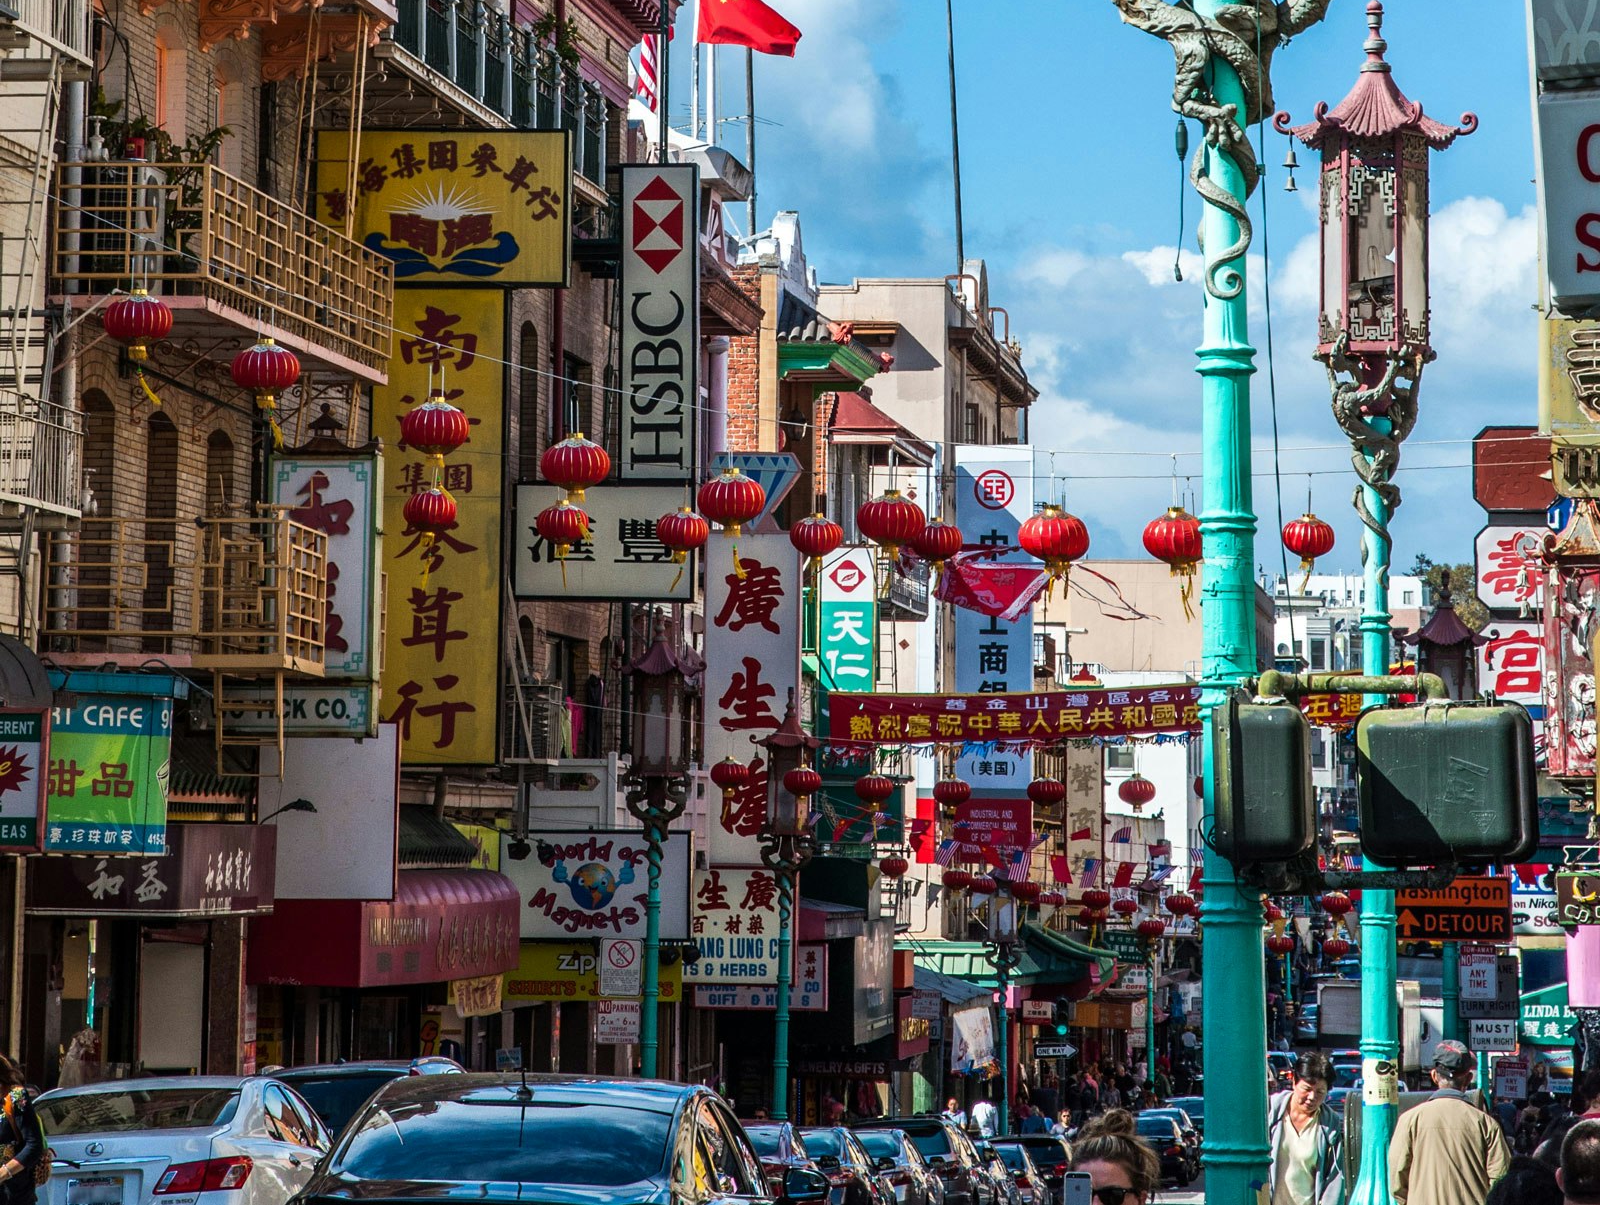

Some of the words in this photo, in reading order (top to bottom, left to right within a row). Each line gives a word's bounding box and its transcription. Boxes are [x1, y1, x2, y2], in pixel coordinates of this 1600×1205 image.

[629, 290, 685, 472] HSBC
[315, 697, 351, 718] CO.
[83, 705, 143, 728] CAFE
[969, 809, 1000, 819] INDUSTRIAL
[1001, 810, 1013, 819] AND
[1002, 822, 1018, 831] BANK
[970, 833, 979, 842] OF
[86, 859, 168, 903] 和益
[527, 887, 640, 934] Magnets
[1424, 912, 1504, 932] DETOUR
[729, 937, 764, 959] LUNG
[1461, 955, 1472, 965] NO
[1472, 955, 1495, 964] STOPPING
[704, 963, 714, 976] &
[719, 963, 767, 976] HERBS
[1469, 969, 1487, 978] ANY
[508, 980, 576, 997] SHIRTS
[1469, 980, 1487, 989] TIME
[599, 1000, 611, 1013] NO
[612, 1004, 639, 1013] PARKING
[1460, 1001, 1486, 1011] TURN
[1489, 1001, 1516, 1011] RIGHT
[1523, 1004, 1560, 1018] LINDA
[600, 1016, 606, 1026] 2
[622, 1017, 628, 1026] 6
[1475, 1024, 1510, 1033] MUST
[1472, 1037, 1490, 1046] TURN
[1493, 1037, 1514, 1046] RIGHT
[854, 1062, 885, 1075] GIFTS
[1505, 1077, 1518, 1085] ANY
[1504, 1085, 1519, 1093] TIME
